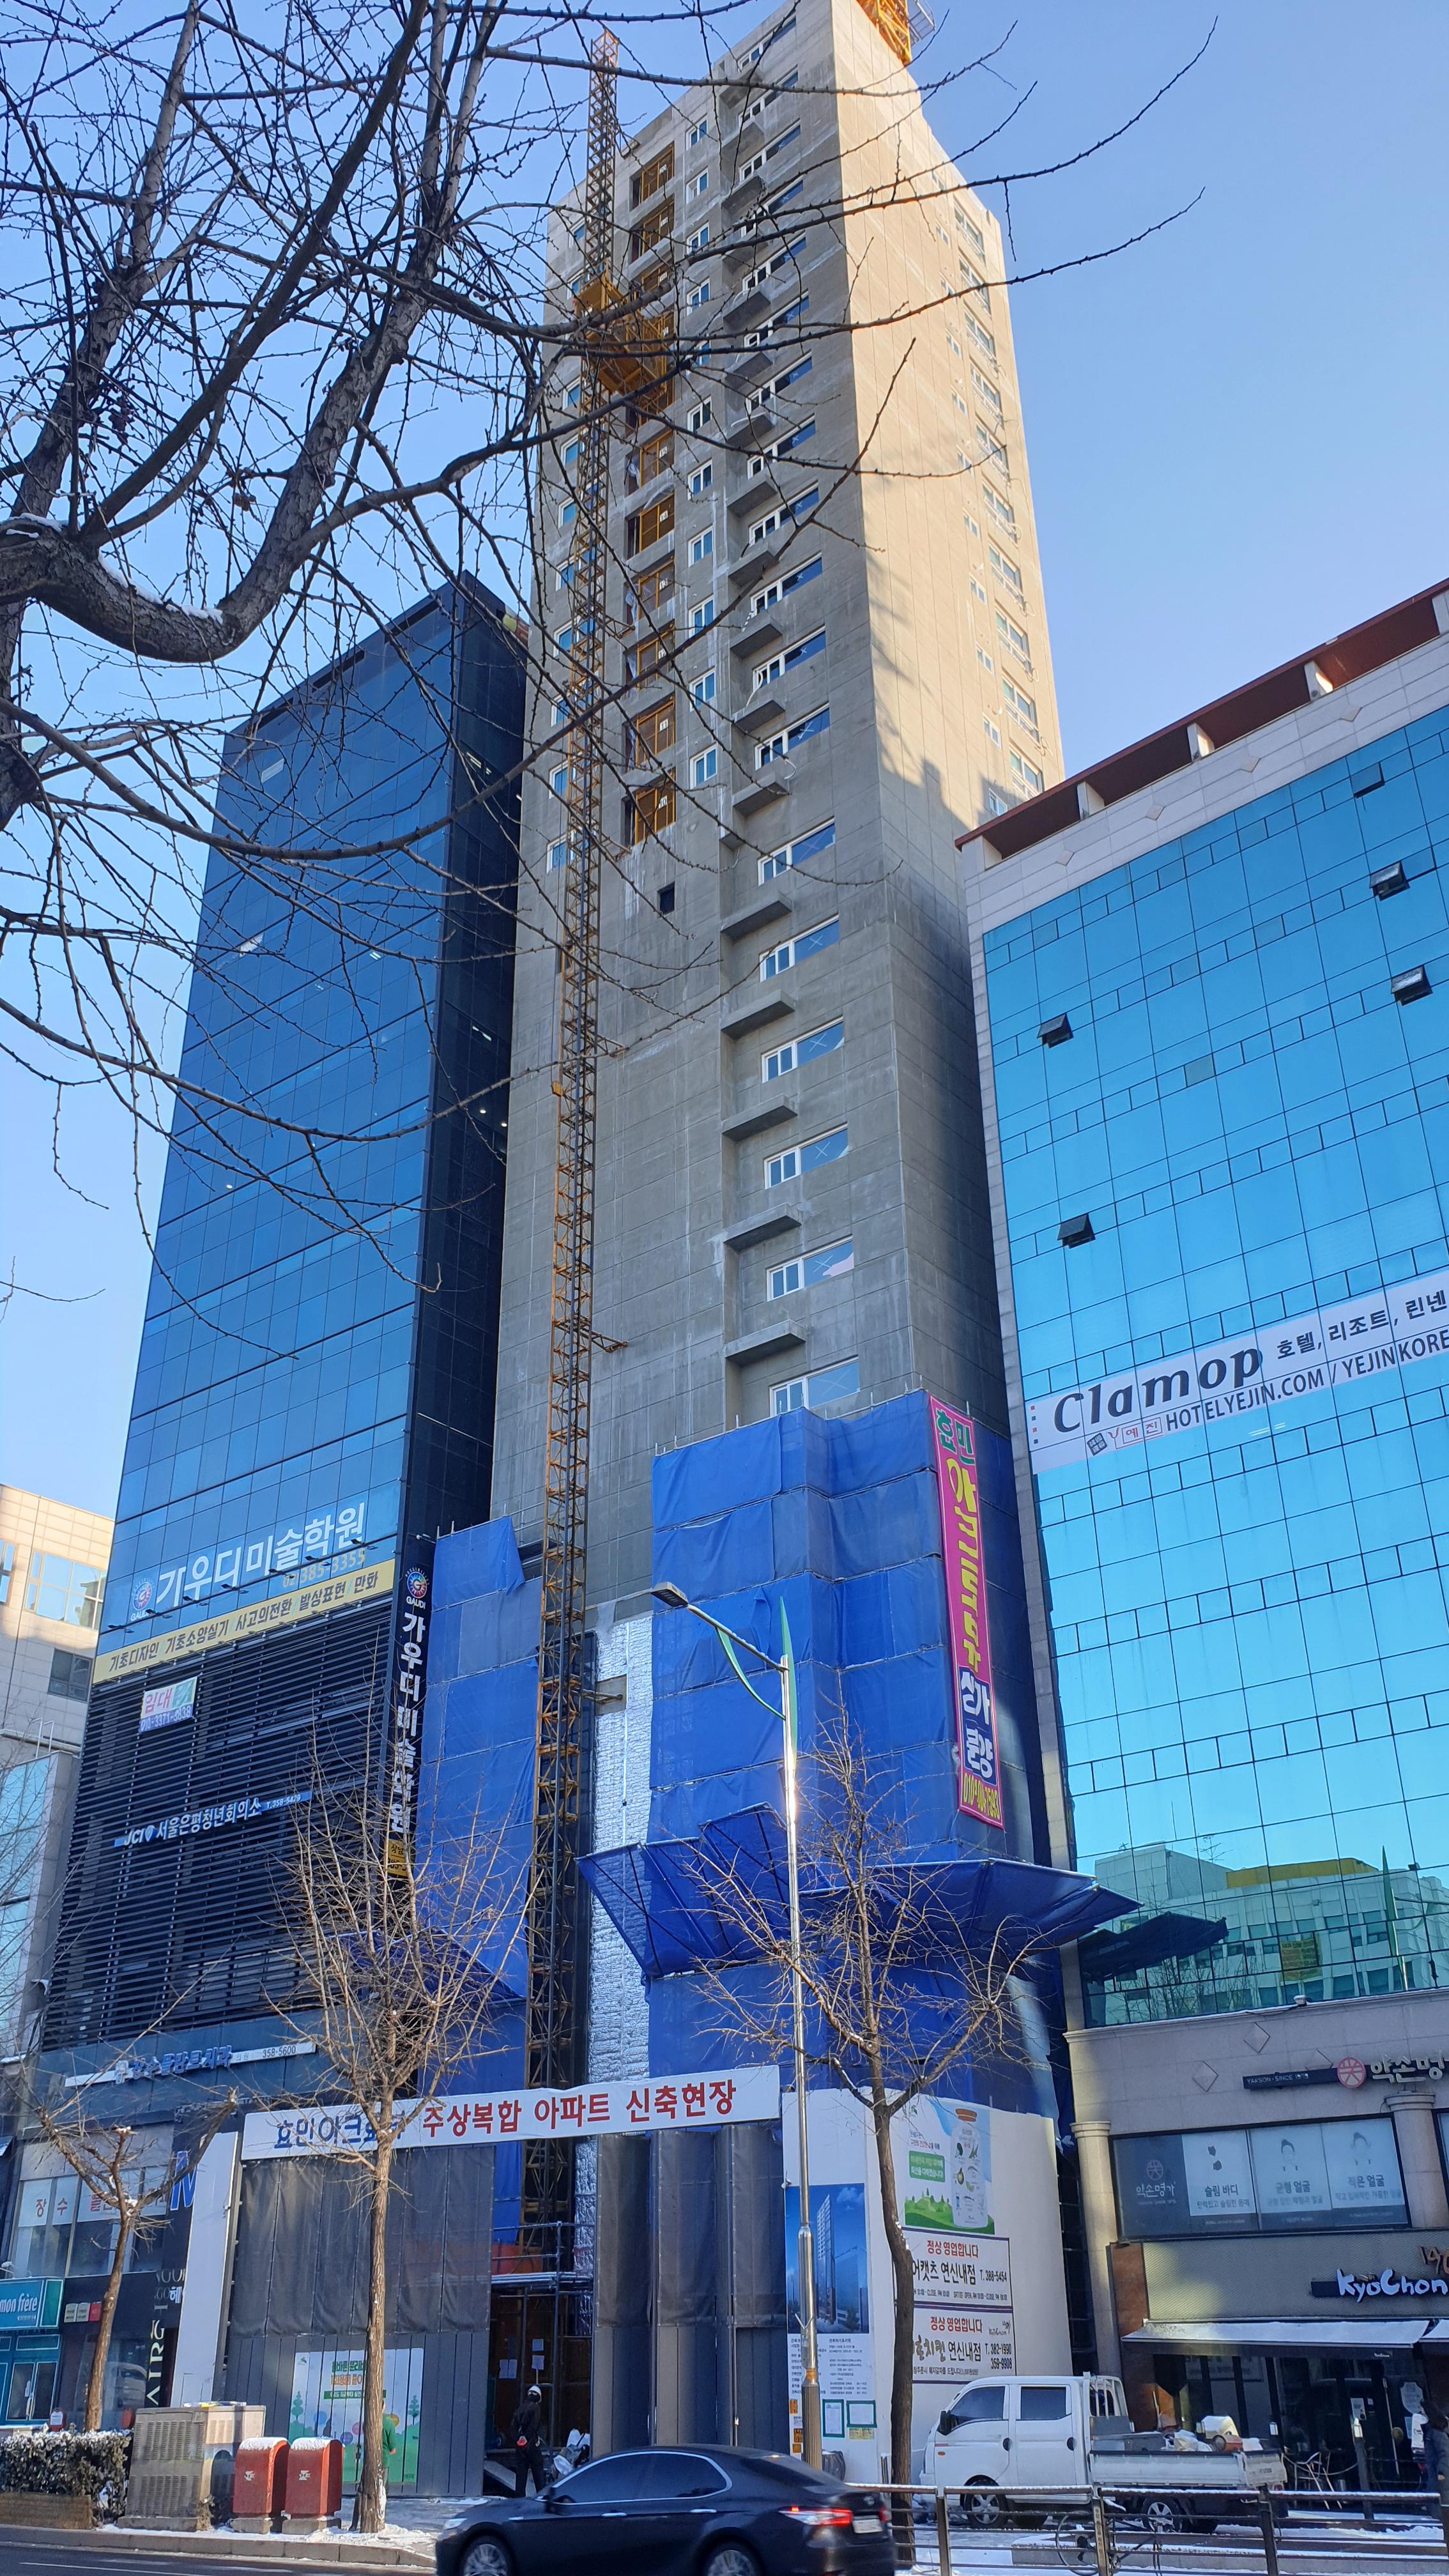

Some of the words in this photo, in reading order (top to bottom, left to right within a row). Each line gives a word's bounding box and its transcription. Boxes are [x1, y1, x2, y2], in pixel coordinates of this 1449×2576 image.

[1328, 1310, 1398, 1341] 리조트,
[1054, 1348, 1263, 1433] Clamop
[1166, 1368, 1324, 1431] HOTELYEJIN.COM
[156, 1503, 365, 1607] 가우디미술학원
[406, 1596, 426, 1609] GAUDI
[109, 1641, 159, 1672] 기초디자인
[165, 1619, 229, 1653] 기초소양실기
[235, 1598, 293, 1632] 사고의전환
[299, 1582, 347, 1611] 발상표현
[354, 1571, 378, 1595] 만화
[145, 1687, 173, 1713] 임대
[157, 1798, 262, 1841] 서울은평청년회의소
[422, 2099, 522, 2138] 주상복합
[534, 2092, 611, 2129] 아파트
[625, 2079, 737, 2123] 신축현장
[1205, 2185, 1220, 2198] 슬림
[1222, 2184, 1238, 2196] 바디
[1293, 2180, 1310, 2193] 얼굴
[1367, 2175, 1385, 2188] 얼굴
[927, 2239, 942, 2255] 정상
[943, 2241, 979, 2258] 영업합니다
[940, 2262, 976, 2285] 연신내점
[930, 2316, 945, 2331] 정상
[947, 2317, 983, 2333] 영업합니다
[948, 2341, 981, 2362] 연신내점
